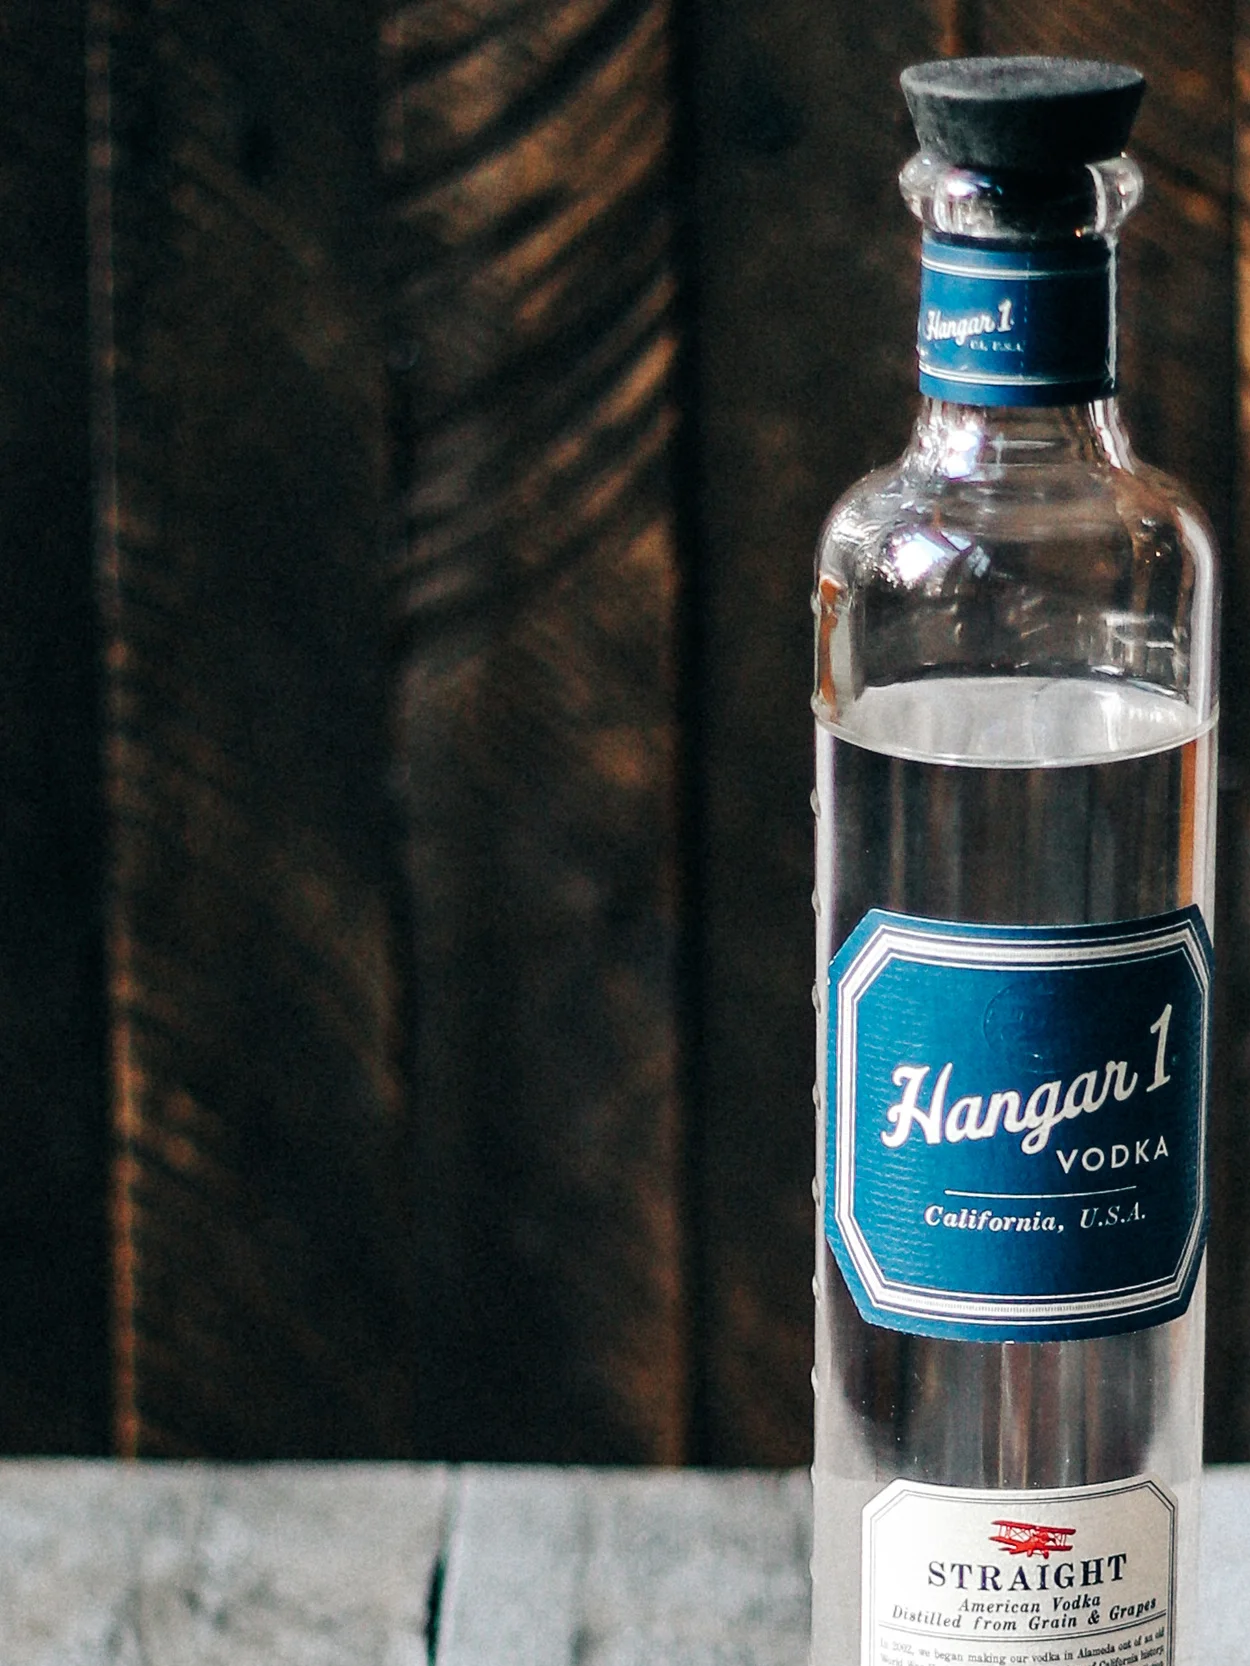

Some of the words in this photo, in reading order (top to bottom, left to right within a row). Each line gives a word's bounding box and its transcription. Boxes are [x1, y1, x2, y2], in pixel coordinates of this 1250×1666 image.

[926, 310, 995, 346] Hangar
[997, 299, 1012, 332] 1
[880, 1060, 1139, 1156] Hangar
[1145, 1003, 1174, 1093] 1
[1055, 1135, 1169, 1175] VODKA
[923, 1203, 1066, 1233] California,
[1079, 1201, 1146, 1230] U.S.A.
[928, 1553, 1127, 1591] STRAIGHT
[892, 1604, 962, 1628] Distilled
[973, 1615, 1017, 1631] from
[1028, 1614, 1077, 1630] Grain
[1087, 1609, 1100, 1625] &
[1109, 1597, 1157, 1621] Grapes
[958, 1598, 1040, 1613] American
[1053, 1593, 1101, 1611] Vodka
[934, 1648, 963, 1663] began
[968, 1653, 1007, 1666] making
[1010, 1654, 1028, 1663] our
[1032, 1652, 1060, 1663] vodka
[1064, 1650, 1074, 1661] in
[1077, 1644, 1115, 1659] Alameda
[1118, 1640, 1132, 1651] out
[1133, 1636, 1143, 1647] of
